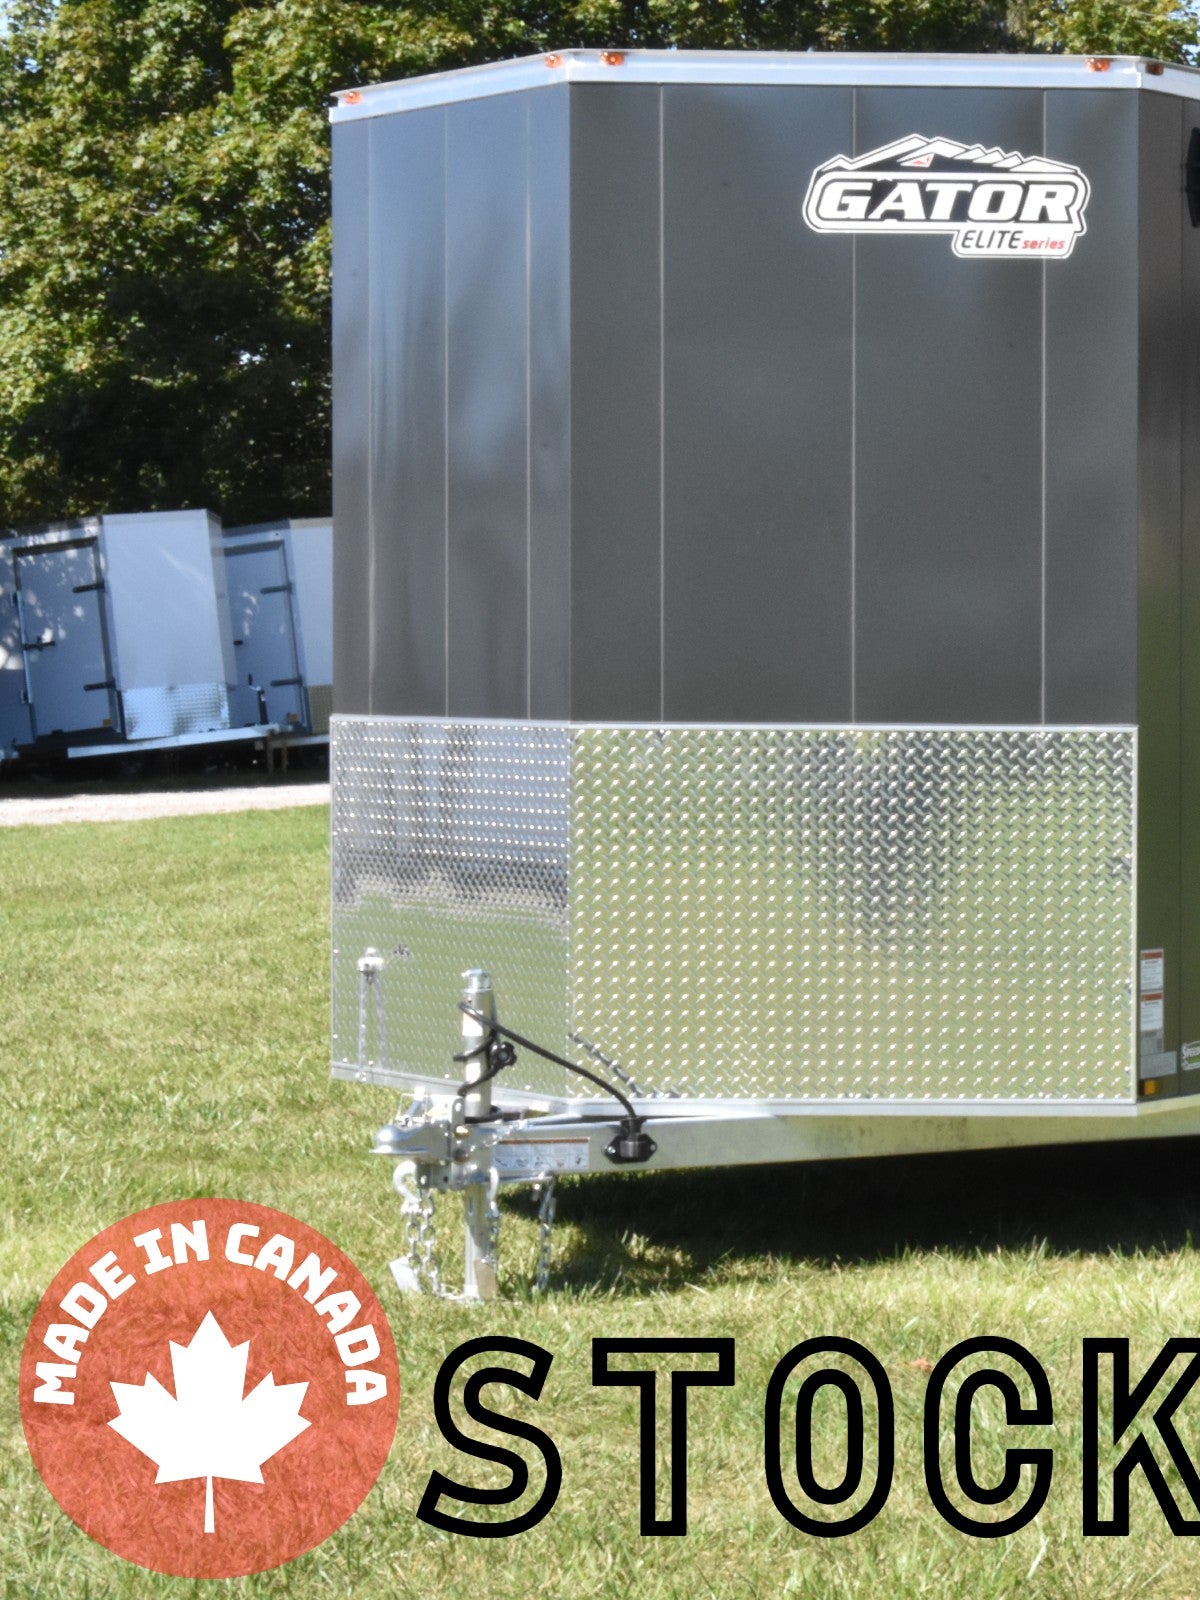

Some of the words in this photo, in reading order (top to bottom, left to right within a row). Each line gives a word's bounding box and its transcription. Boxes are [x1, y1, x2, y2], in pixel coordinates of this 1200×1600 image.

[816, 178, 1078, 224] GATOR
[961, 229, 1024, 250] ELITE
[1022, 237, 1066, 250] series
